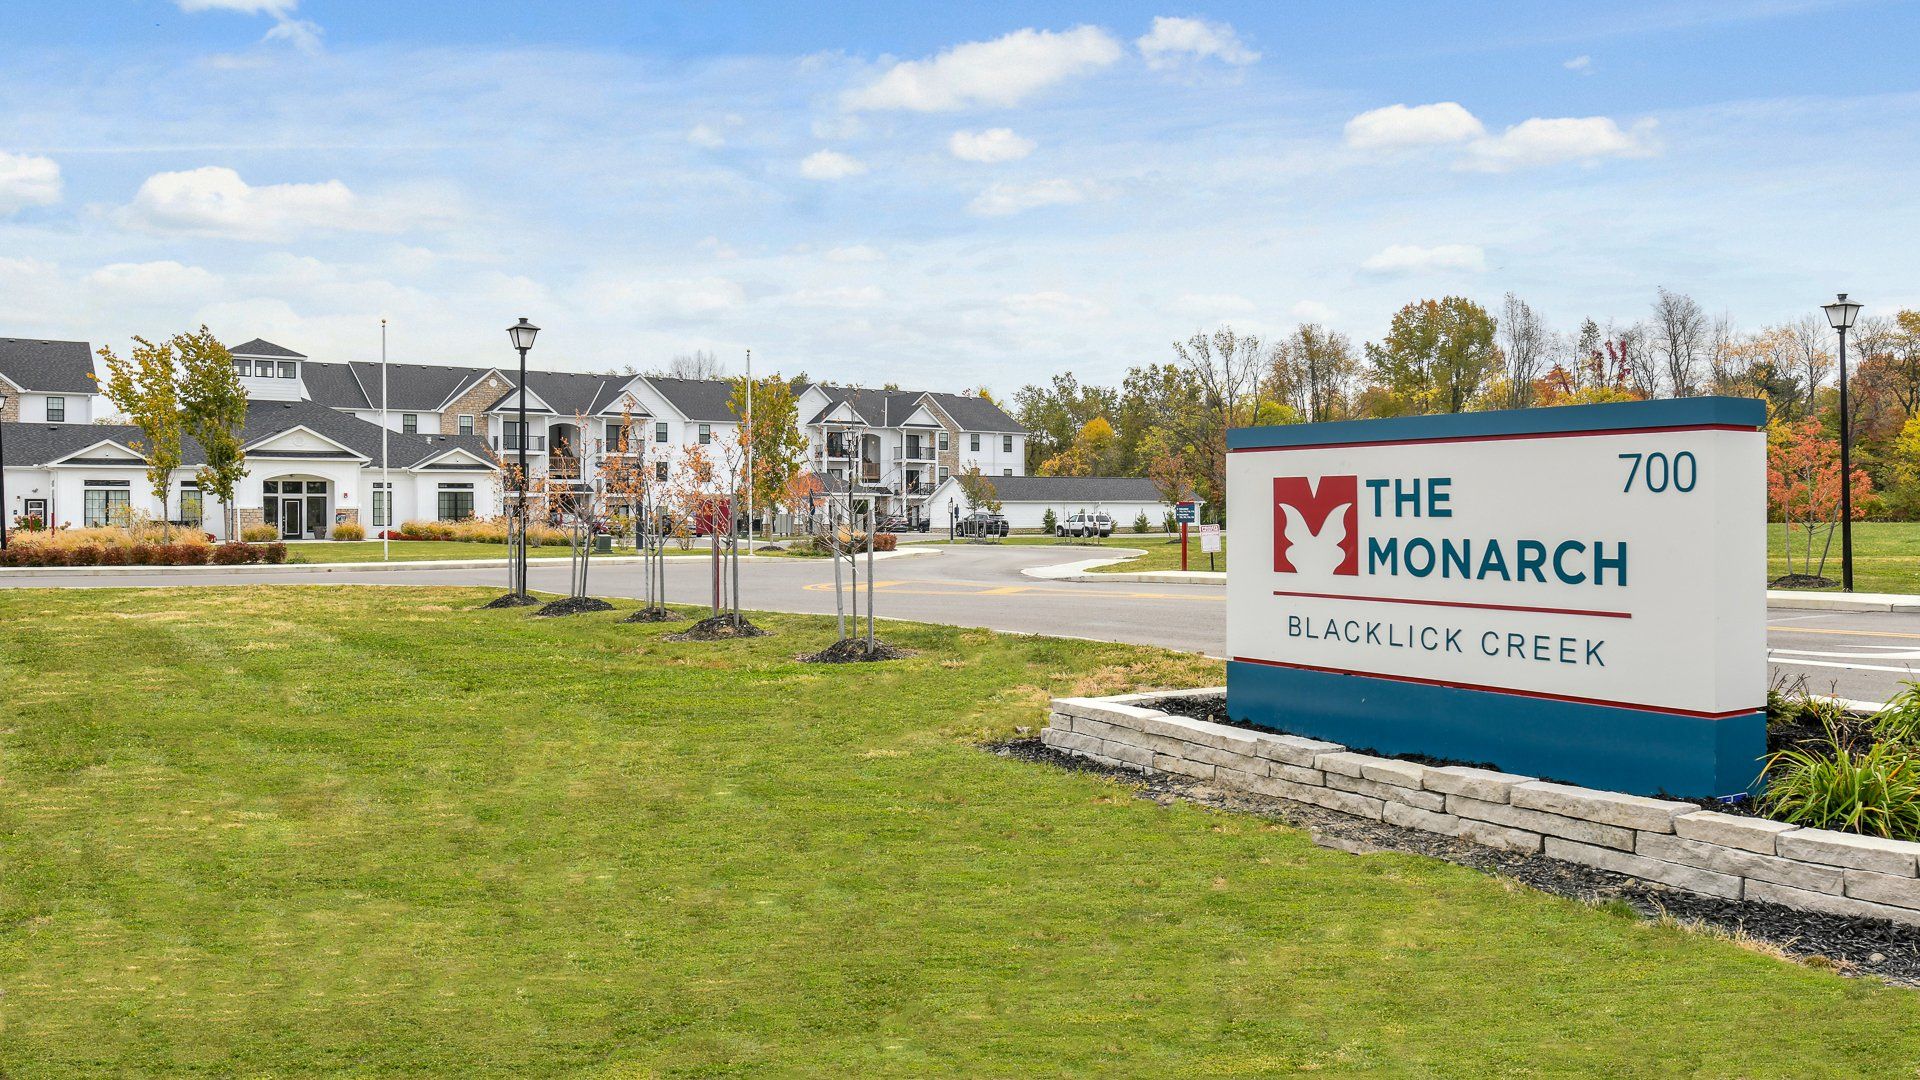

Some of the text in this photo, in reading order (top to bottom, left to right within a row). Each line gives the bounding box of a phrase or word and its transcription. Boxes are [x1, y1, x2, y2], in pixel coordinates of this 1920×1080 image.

[1618, 450, 1697, 494] 700
[1365, 477, 1453, 518] THE
[1368, 536, 1628, 587] MONARCH
[1288, 615, 1605, 667] BLACKLICK CREEK
